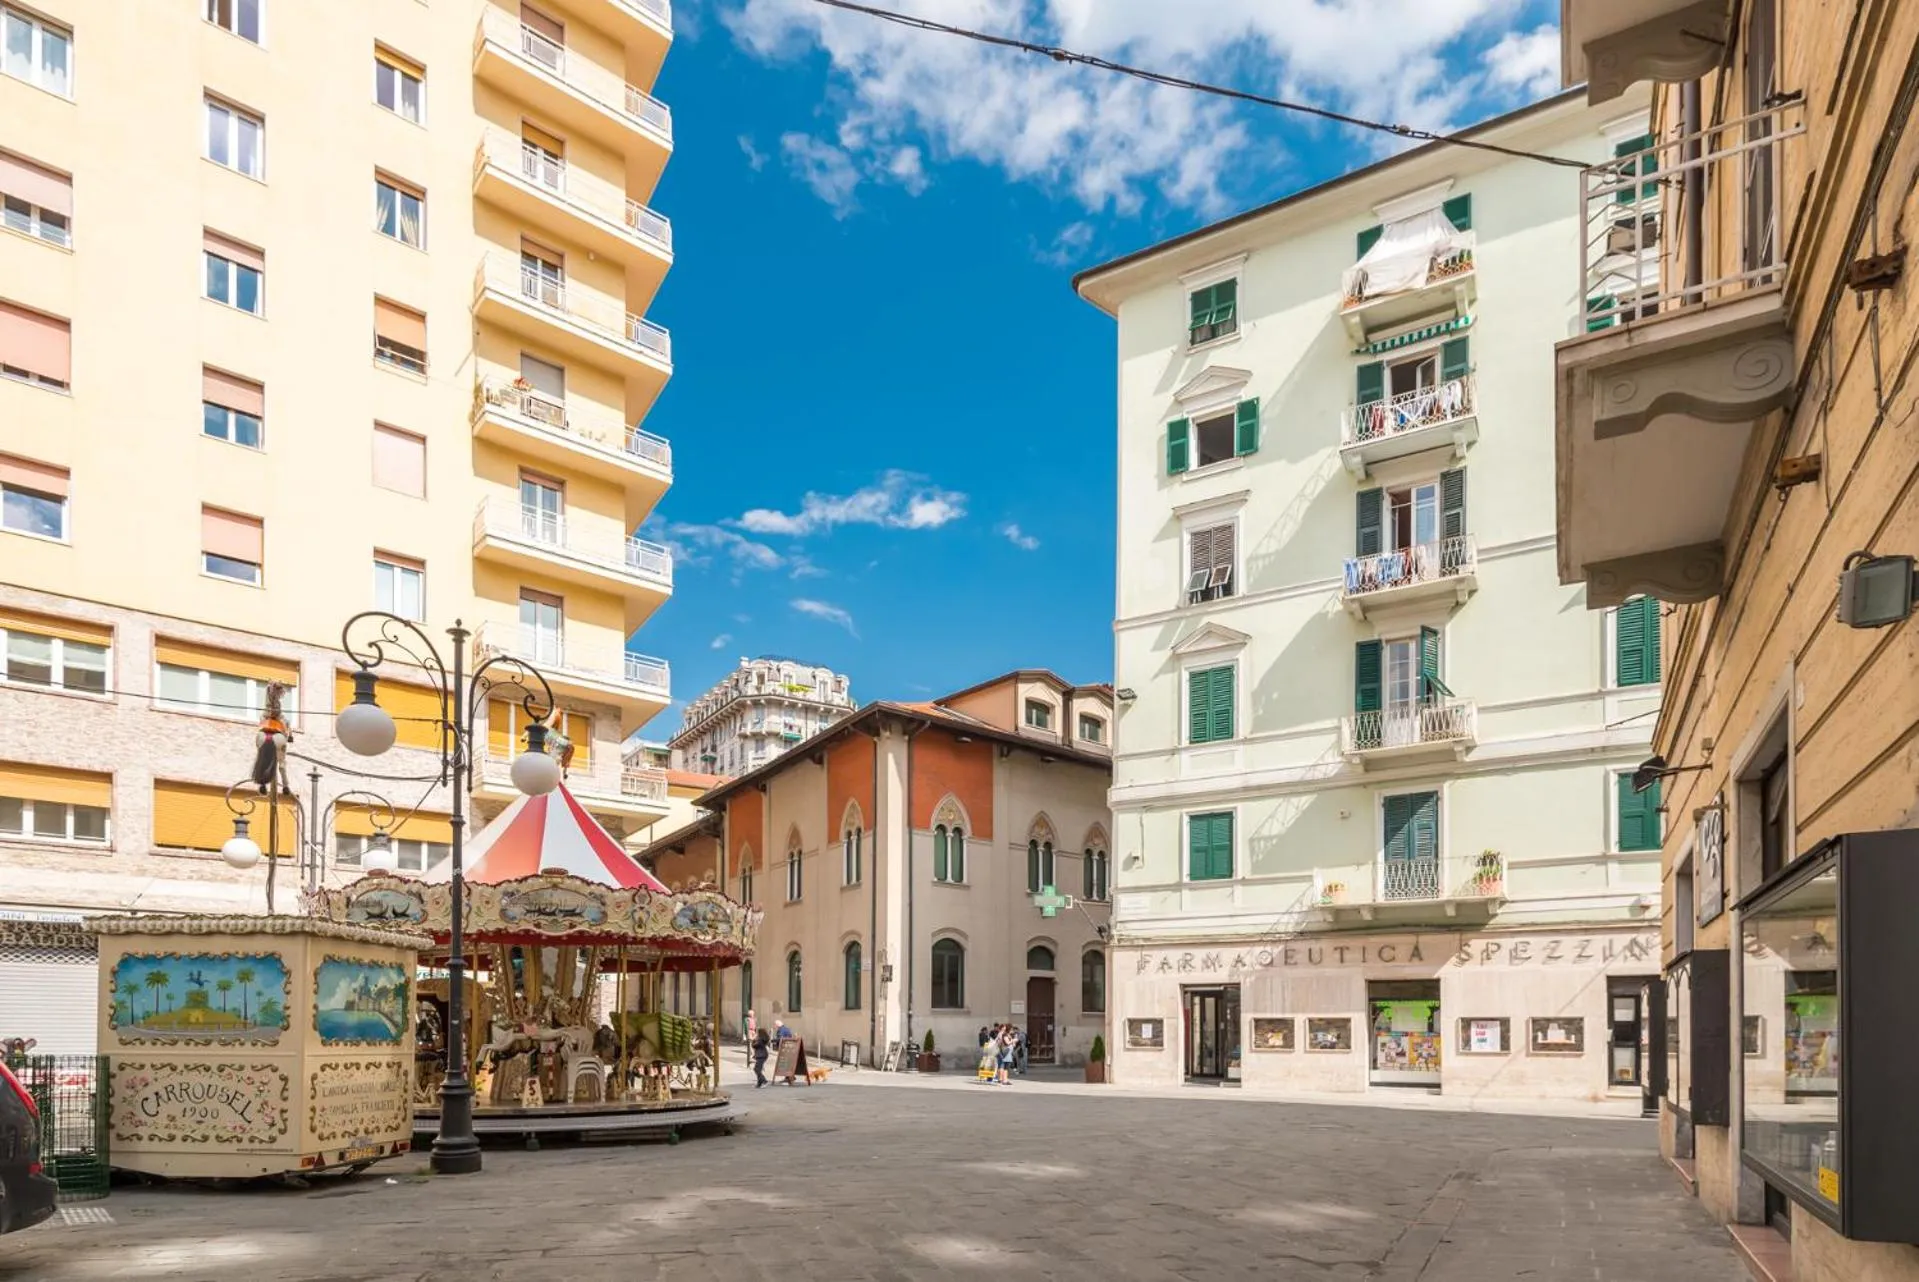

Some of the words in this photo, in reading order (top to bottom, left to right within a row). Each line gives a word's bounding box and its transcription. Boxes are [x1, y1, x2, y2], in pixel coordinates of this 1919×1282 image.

[1138, 943, 1424, 971] FARMACEUTICA
[141, 1081, 252, 1124] CARROUSEL
[182, 1106, 219, 1119] 1900
